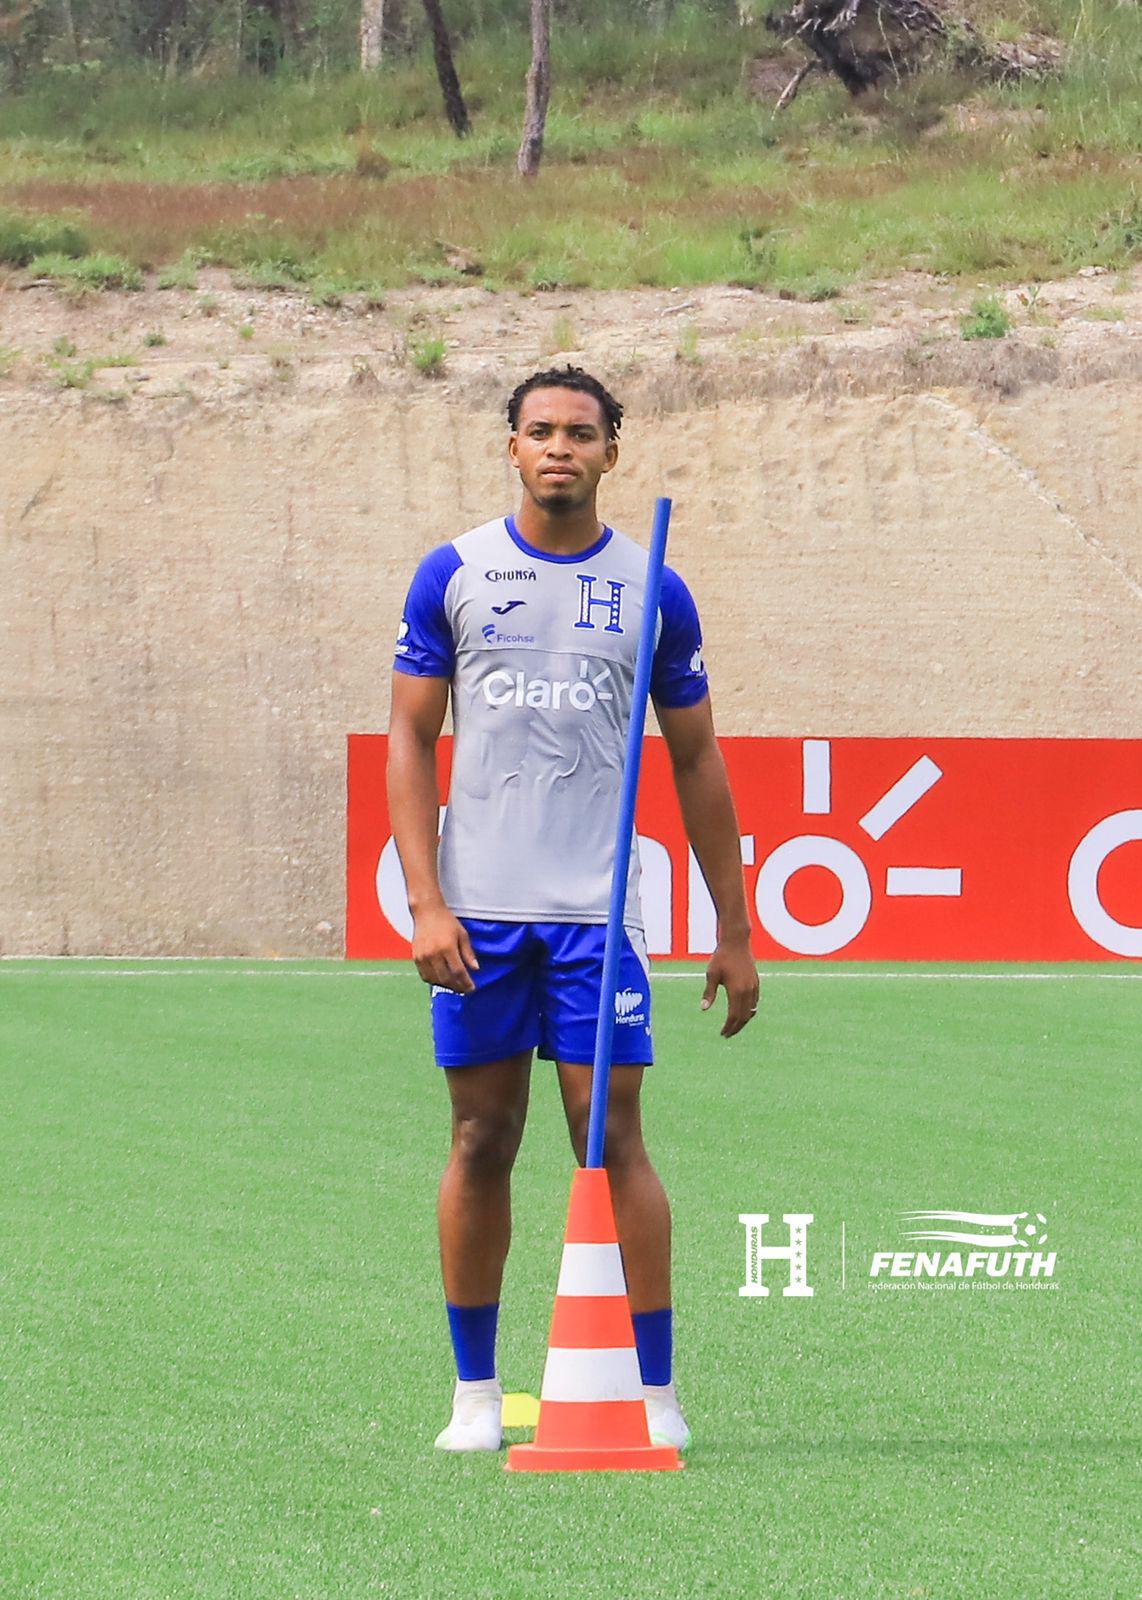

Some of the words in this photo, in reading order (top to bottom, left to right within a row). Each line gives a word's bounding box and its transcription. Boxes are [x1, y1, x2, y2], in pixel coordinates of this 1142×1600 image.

[574, 574, 625, 634] H
[497, 633, 535, 643] Ficohsa
[483, 670, 597, 711] Claro
